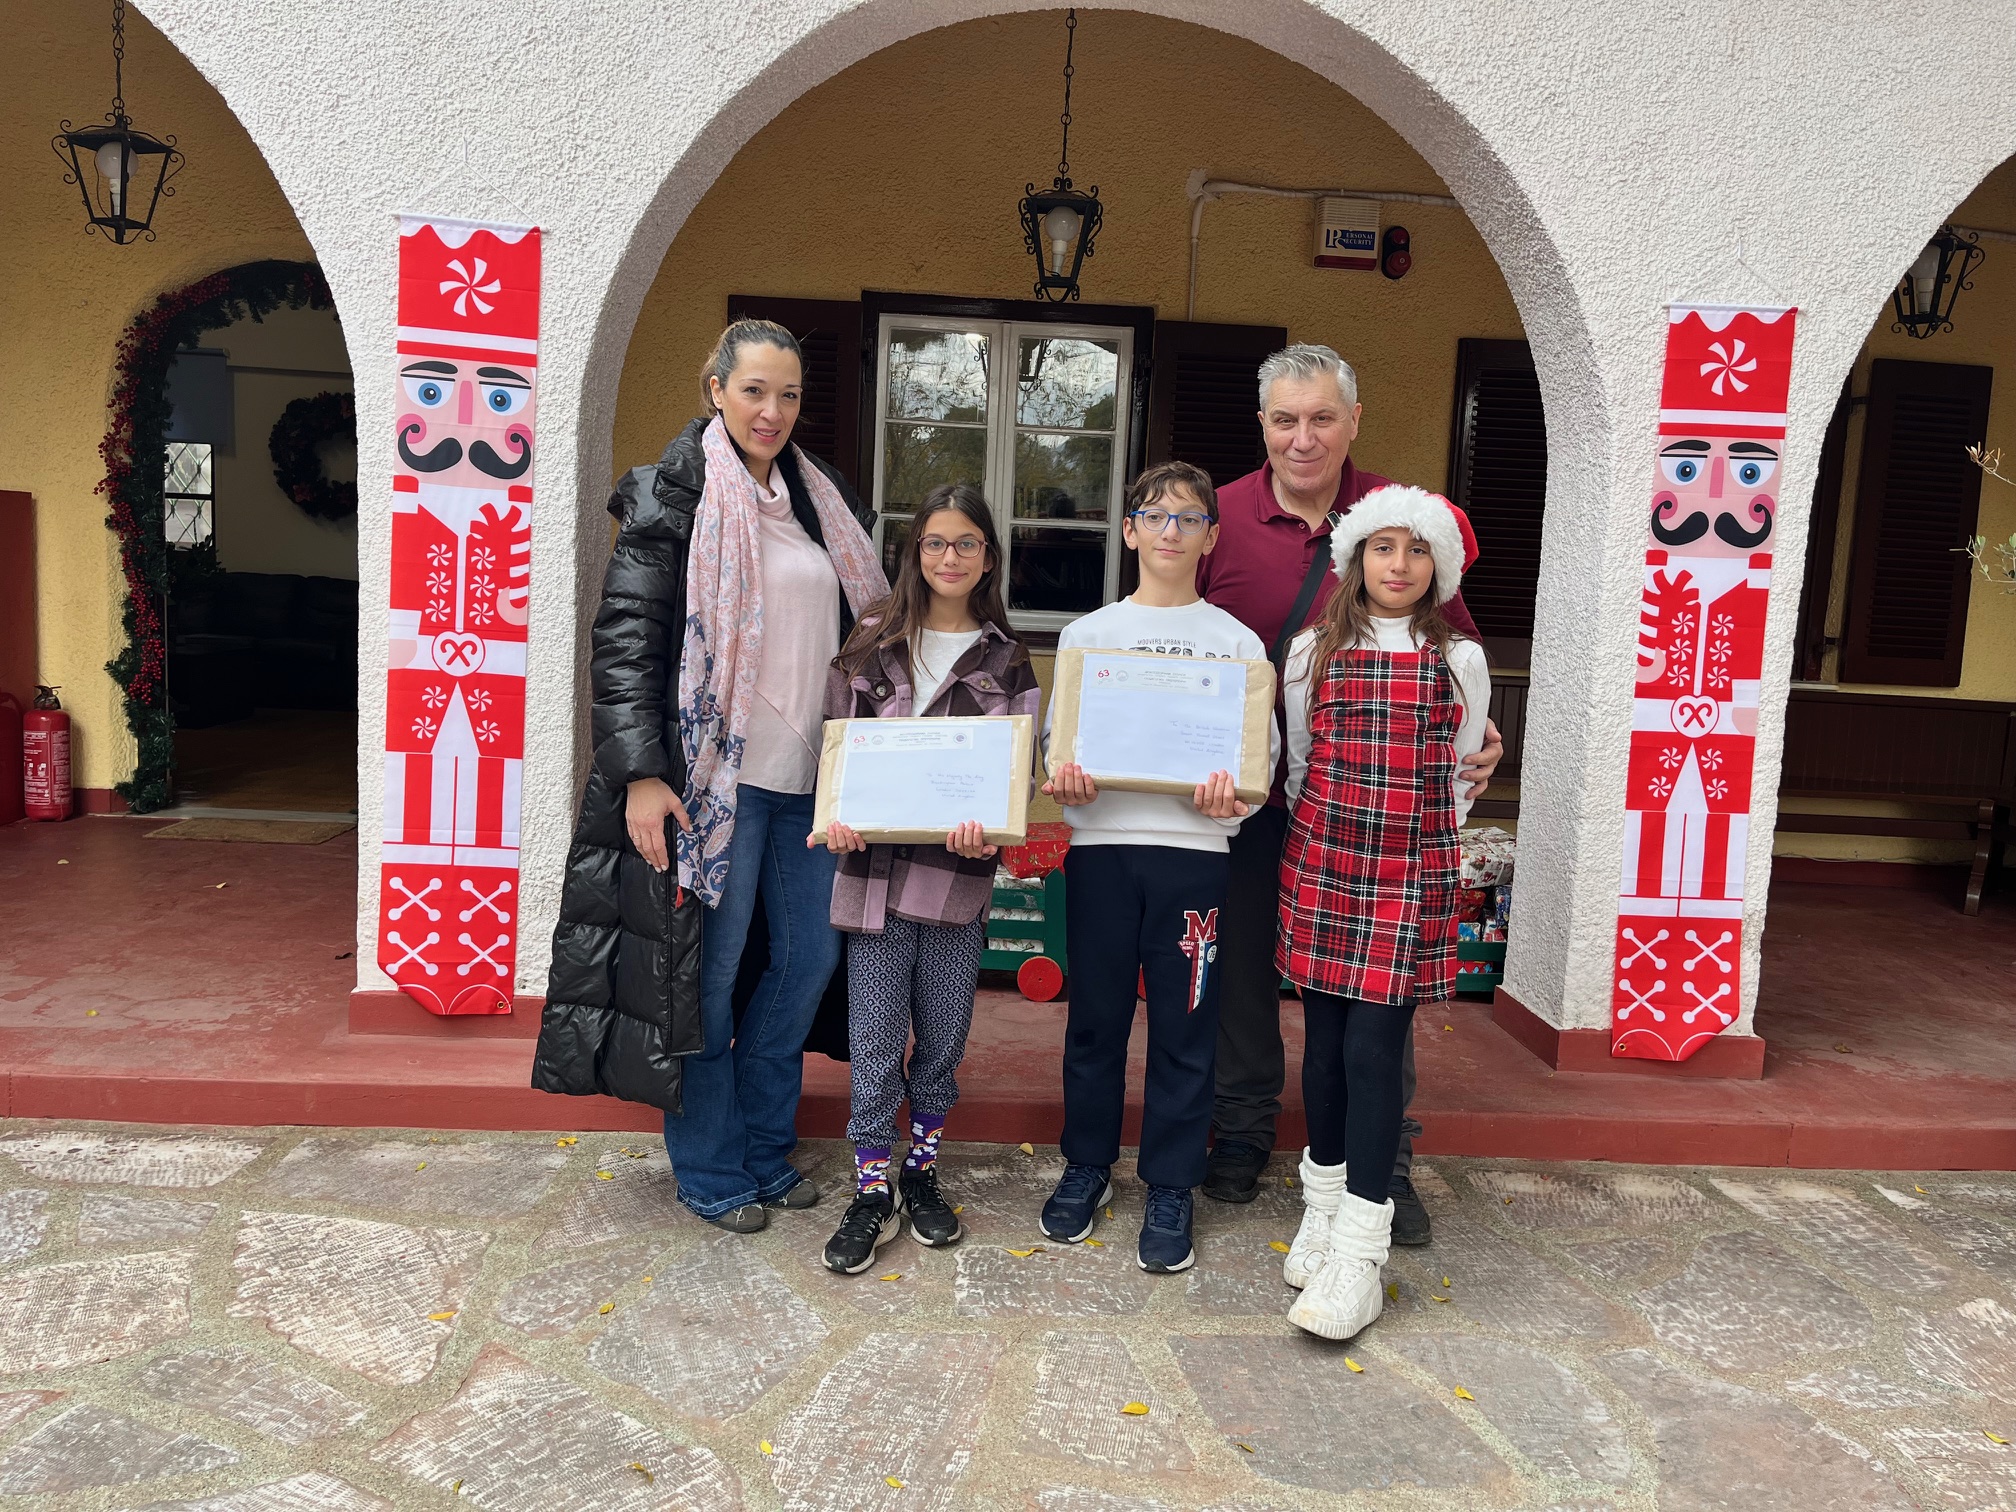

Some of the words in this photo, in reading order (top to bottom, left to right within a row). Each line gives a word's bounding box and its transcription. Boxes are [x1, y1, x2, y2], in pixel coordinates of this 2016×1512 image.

[1137, 638, 1162, 646] MOOVERS
[1182, 640, 1197, 648] STYLE
[1097, 669, 1110, 678] 63
[853, 735, 866, 744] 63
